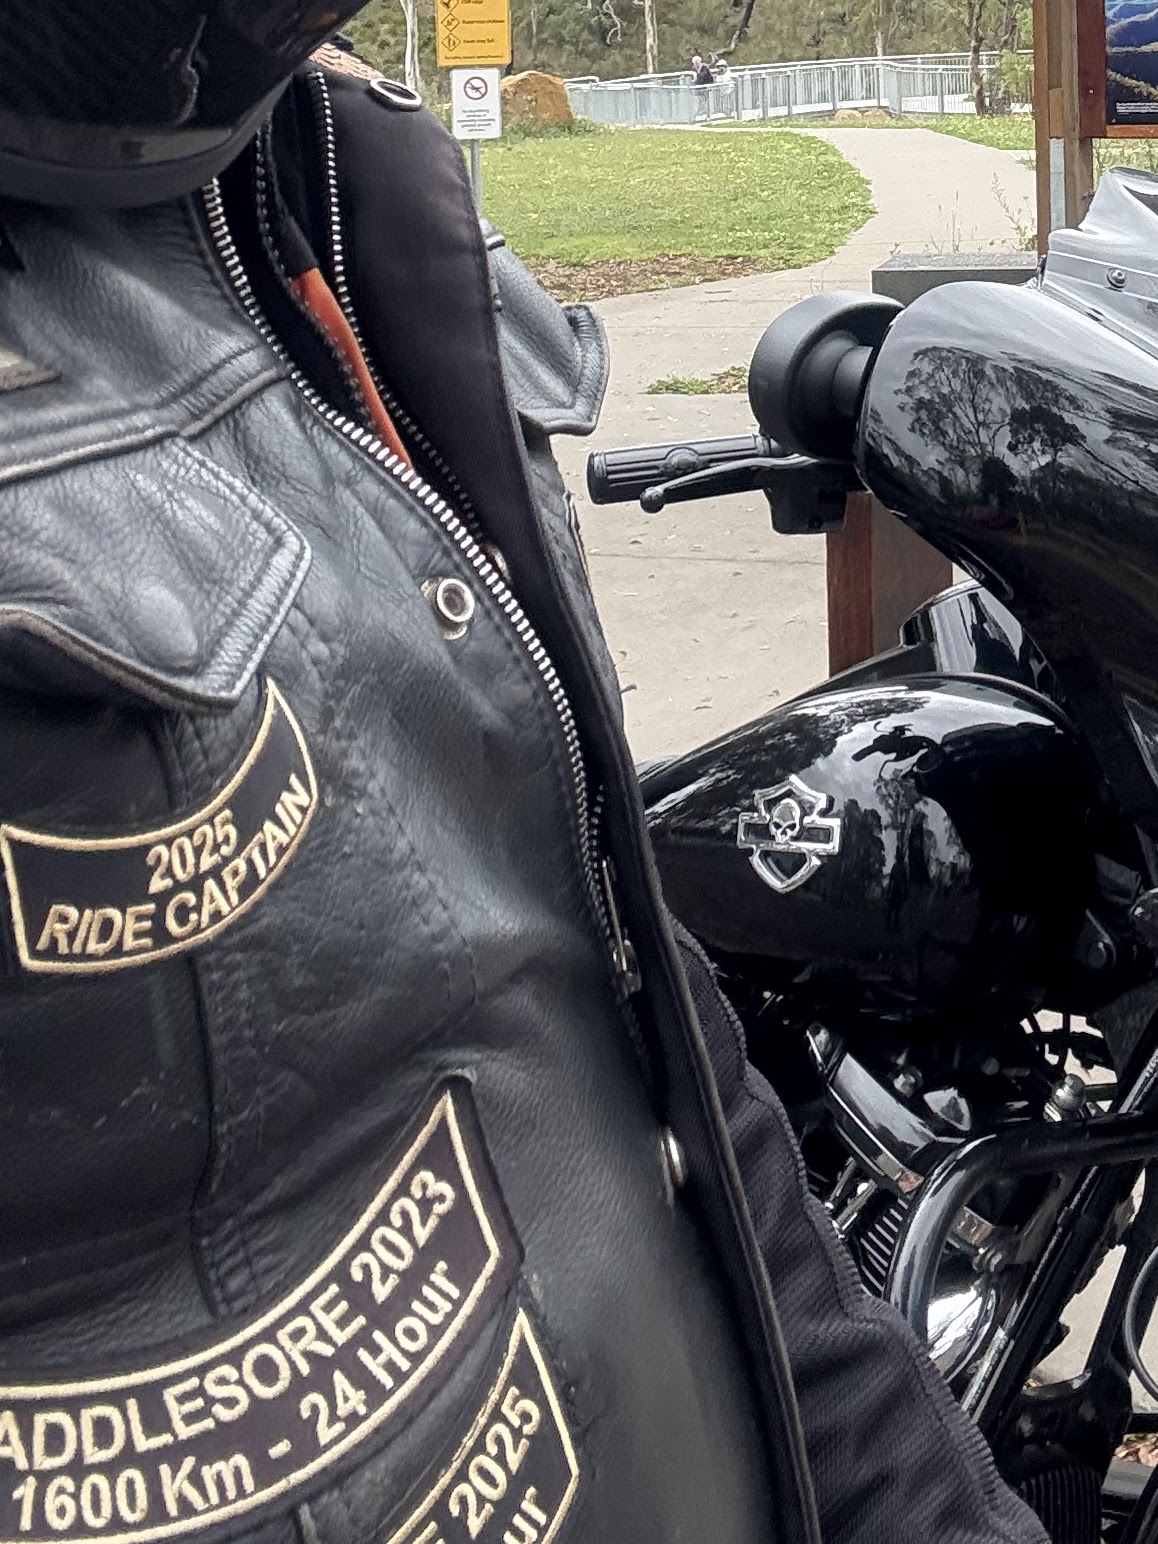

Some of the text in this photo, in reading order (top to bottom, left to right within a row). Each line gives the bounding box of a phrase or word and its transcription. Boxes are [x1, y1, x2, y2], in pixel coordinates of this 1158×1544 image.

[35, 773, 311, 955] RIDE CAPTAIN
[146, 809, 238, 894] 2025
[349, 1170, 456, 1305] 2023
[12, 1467, 148, 1532] 1600
[158, 1453, 255, 1518] Km
[299, 1368, 368, 1447] 24
[356, 1260, 461, 1391] Hour
[448, 1386, 541, 1540] 2025
